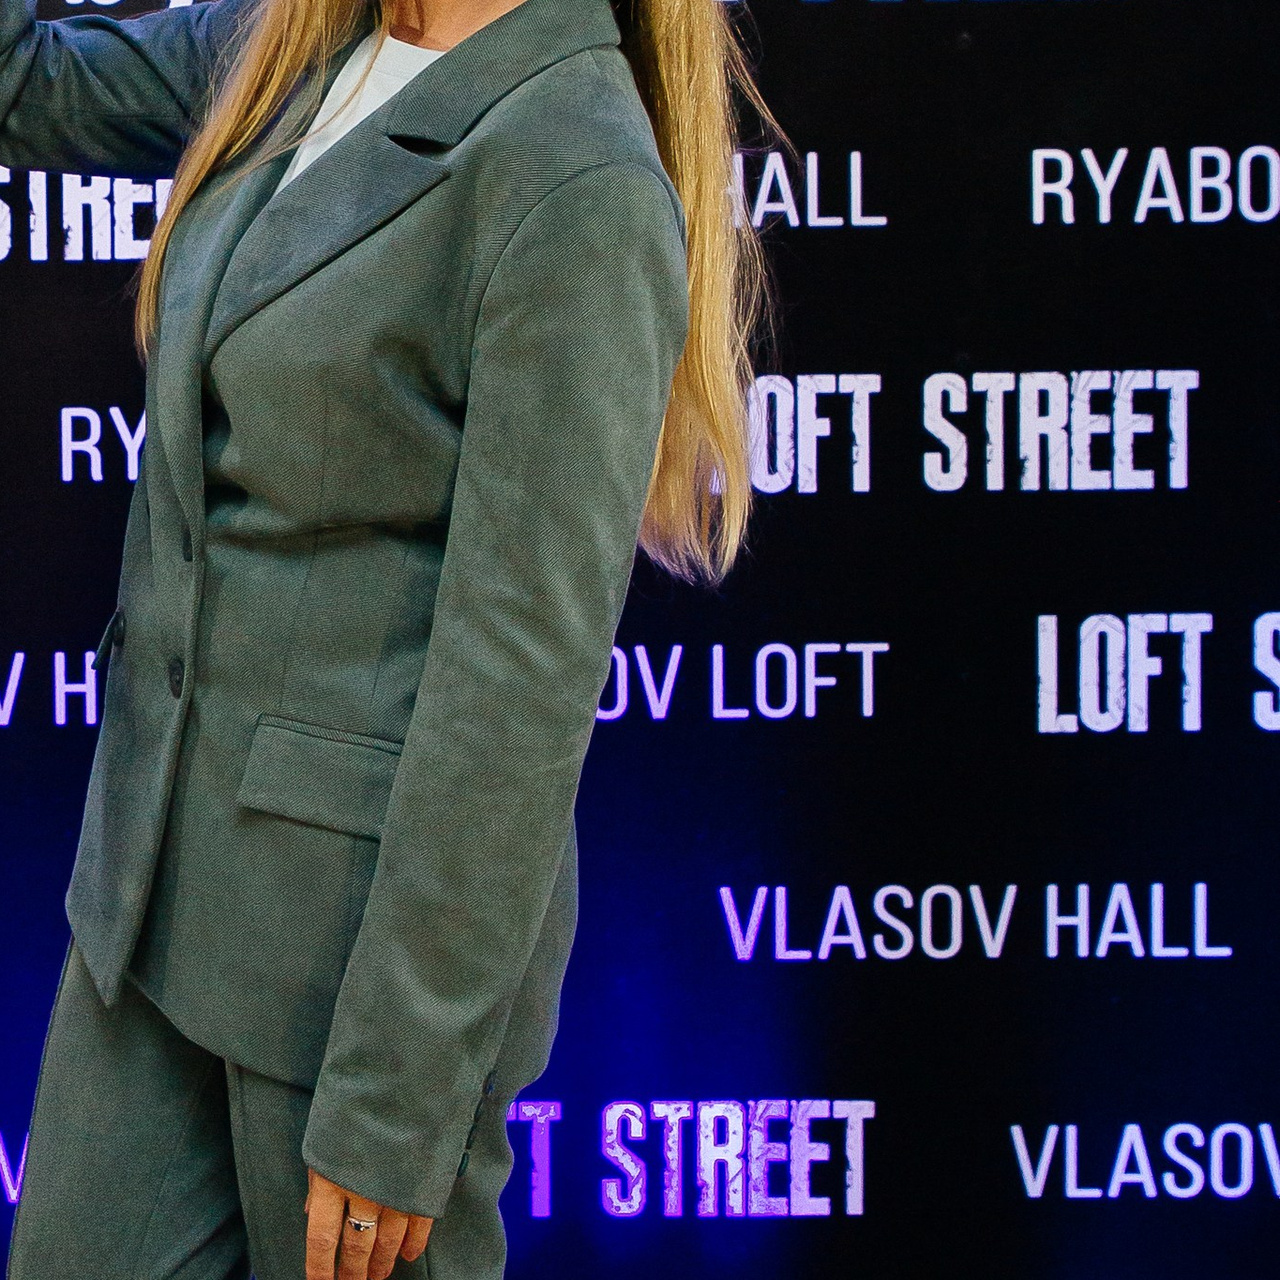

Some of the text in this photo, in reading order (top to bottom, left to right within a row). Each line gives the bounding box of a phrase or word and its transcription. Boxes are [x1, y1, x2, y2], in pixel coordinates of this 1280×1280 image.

[1031, 145, 1280, 225] RYABO
[746, 369, 1200, 493] OFT STREET
[712, 642, 890, 718] LOFT
[1037, 612, 1213, 734] LOFT
[719, 882, 1232, 960] VLASOV HALL
[602, 1100, 876, 1218] STREET
